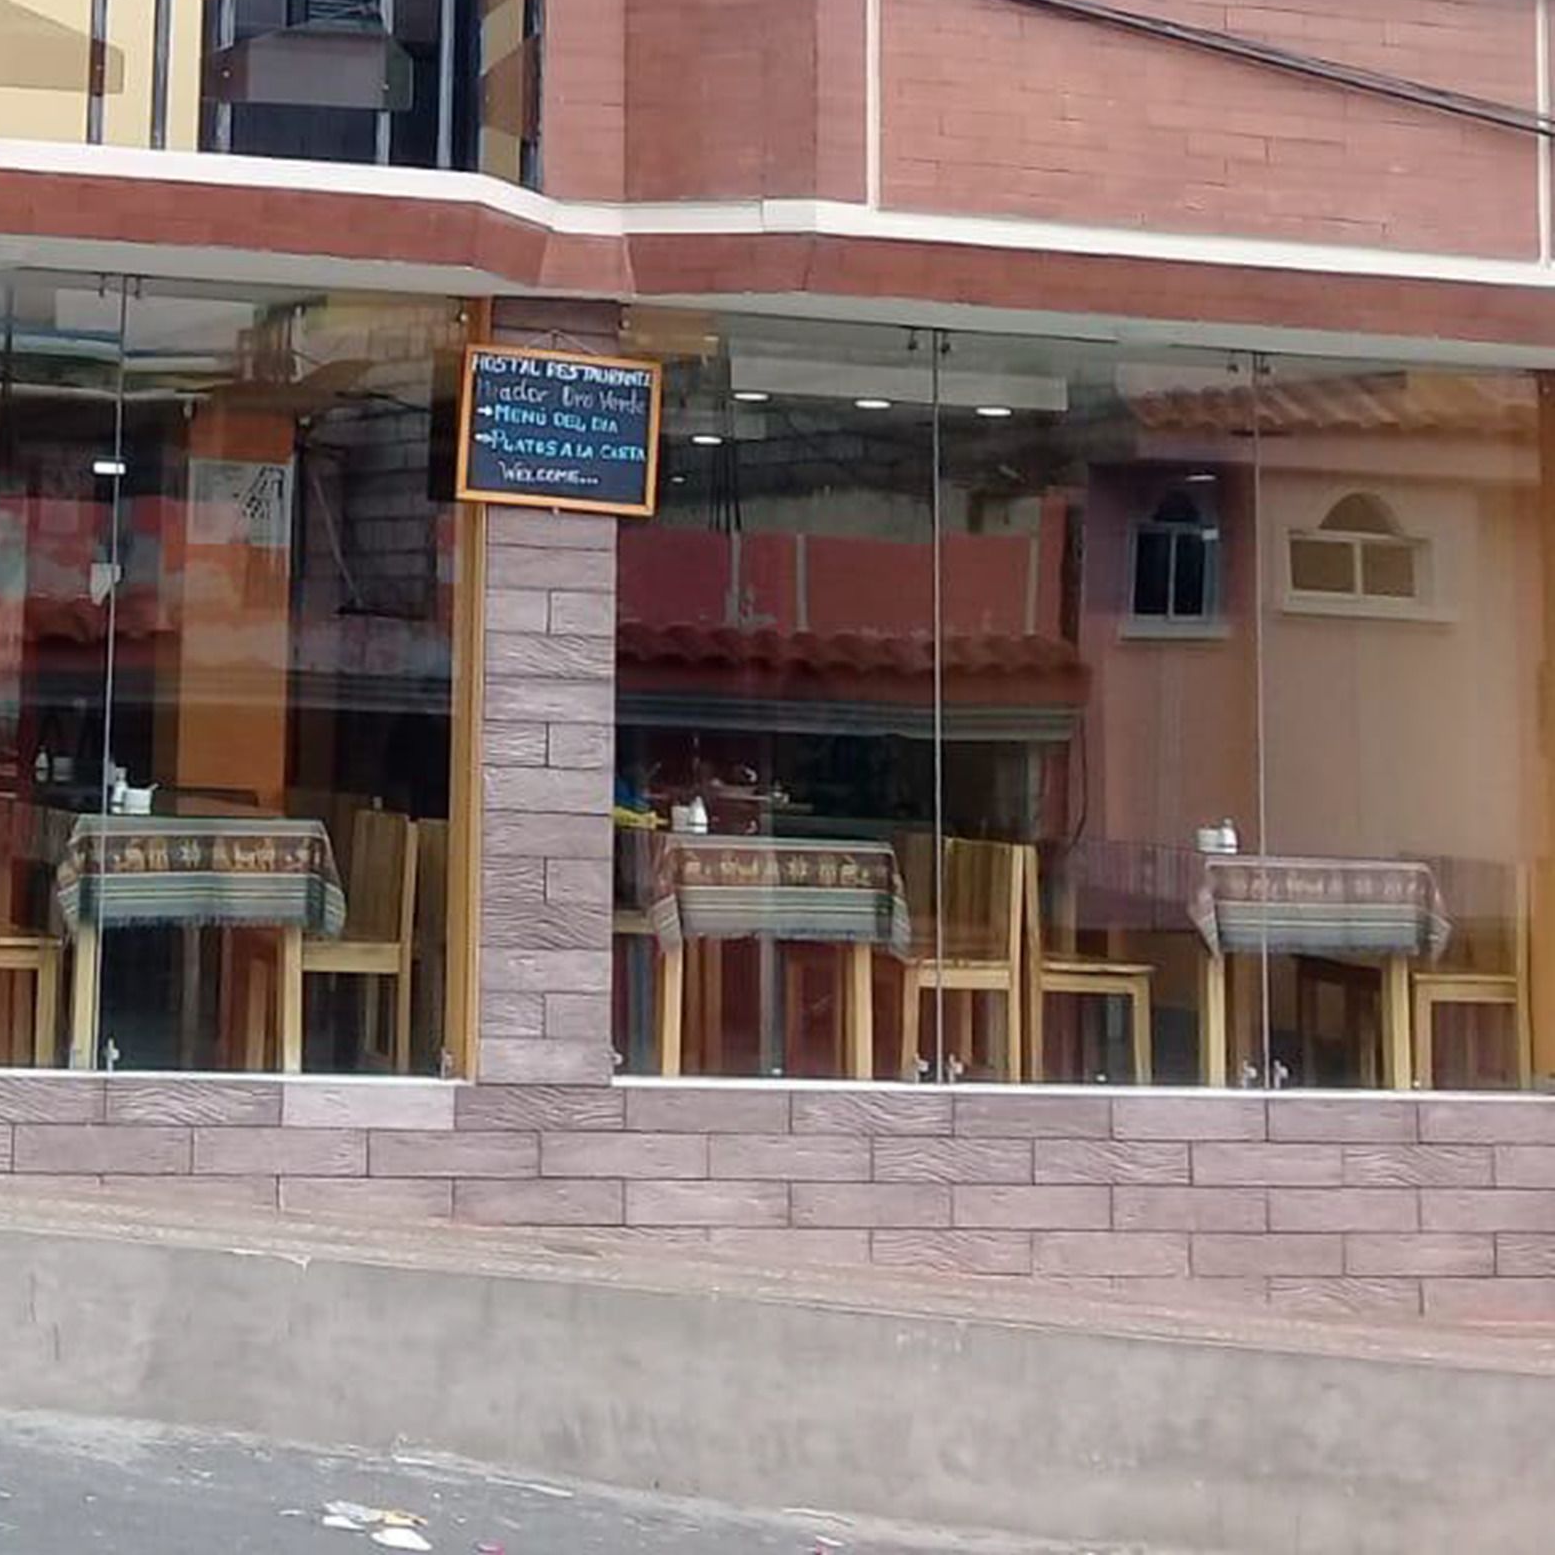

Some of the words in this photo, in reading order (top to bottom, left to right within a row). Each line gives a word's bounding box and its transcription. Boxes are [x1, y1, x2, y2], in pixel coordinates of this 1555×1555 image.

[472, 355, 541, 377] HOSTAL
[553, 412, 586, 432] DEL
[591, 416, 619, 434] DIA
[559, 442, 575, 458] A
[576, 444, 593, 459] LA
